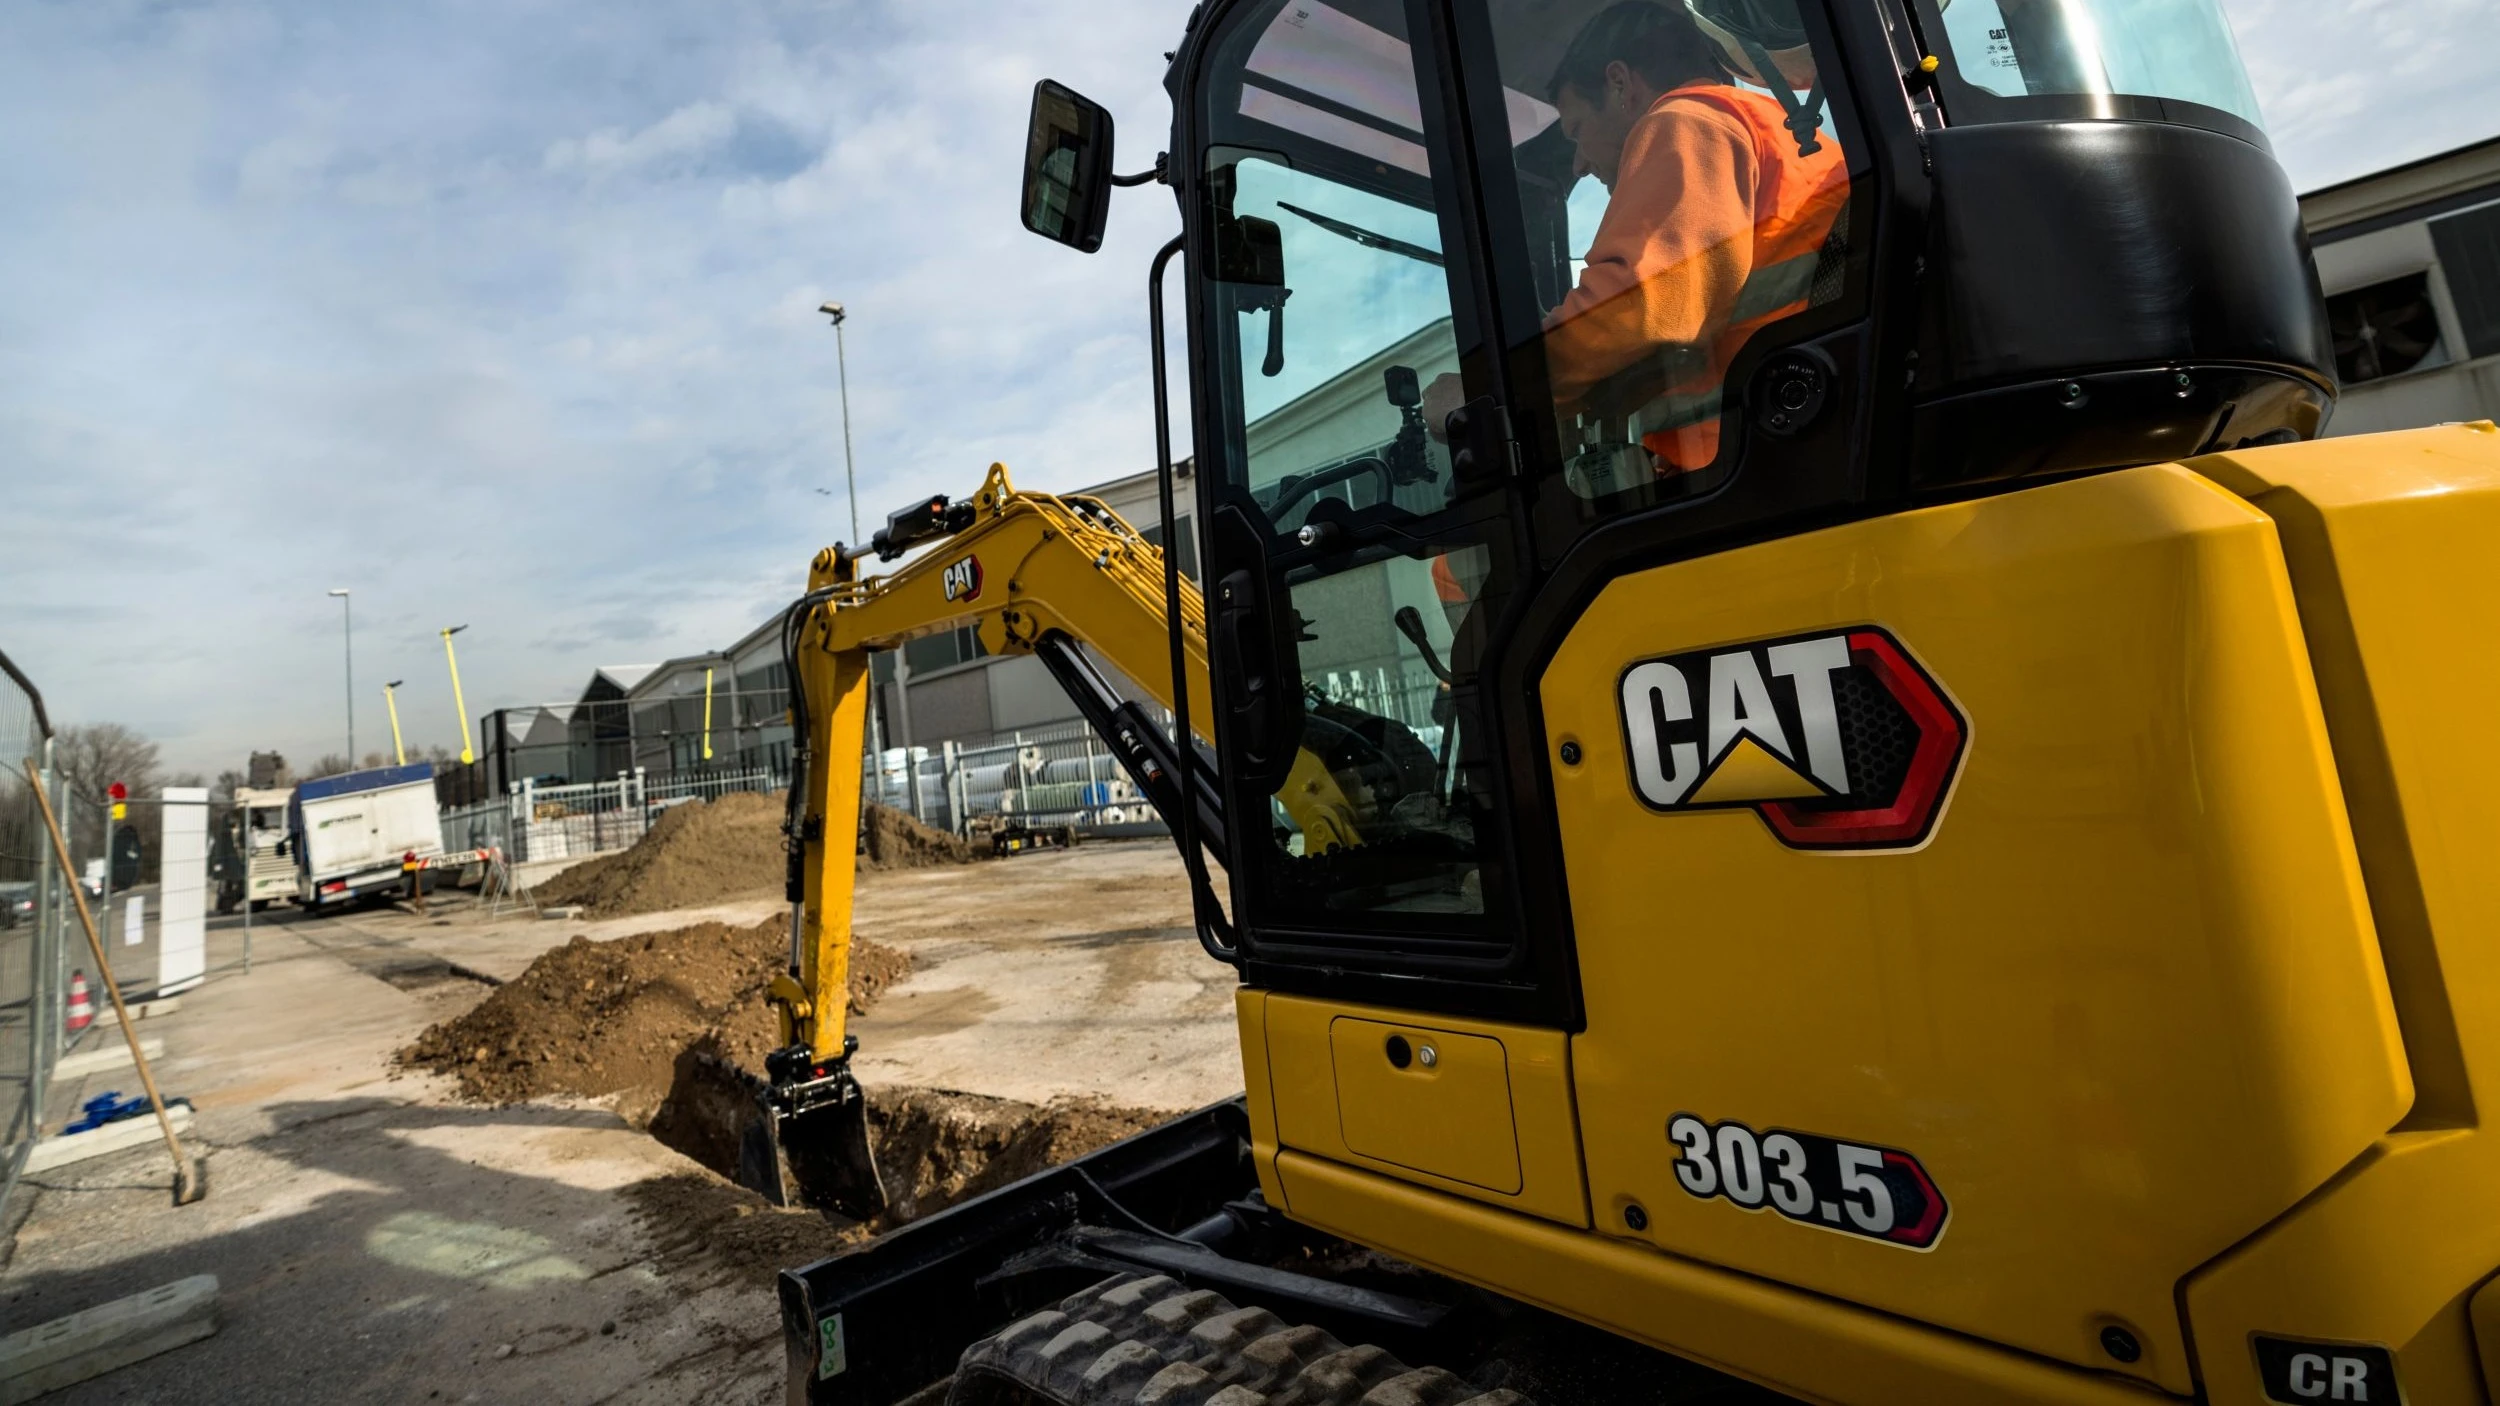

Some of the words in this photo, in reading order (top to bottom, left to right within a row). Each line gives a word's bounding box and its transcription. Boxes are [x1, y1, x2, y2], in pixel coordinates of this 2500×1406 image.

[1989, 28, 2007, 40] CAT
[944, 557, 973, 600] CAT
[1623, 635, 1851, 804] CAT
[1671, 1118, 1895, 1234] 303.5
[2289, 1353, 2369, 1402] CR
